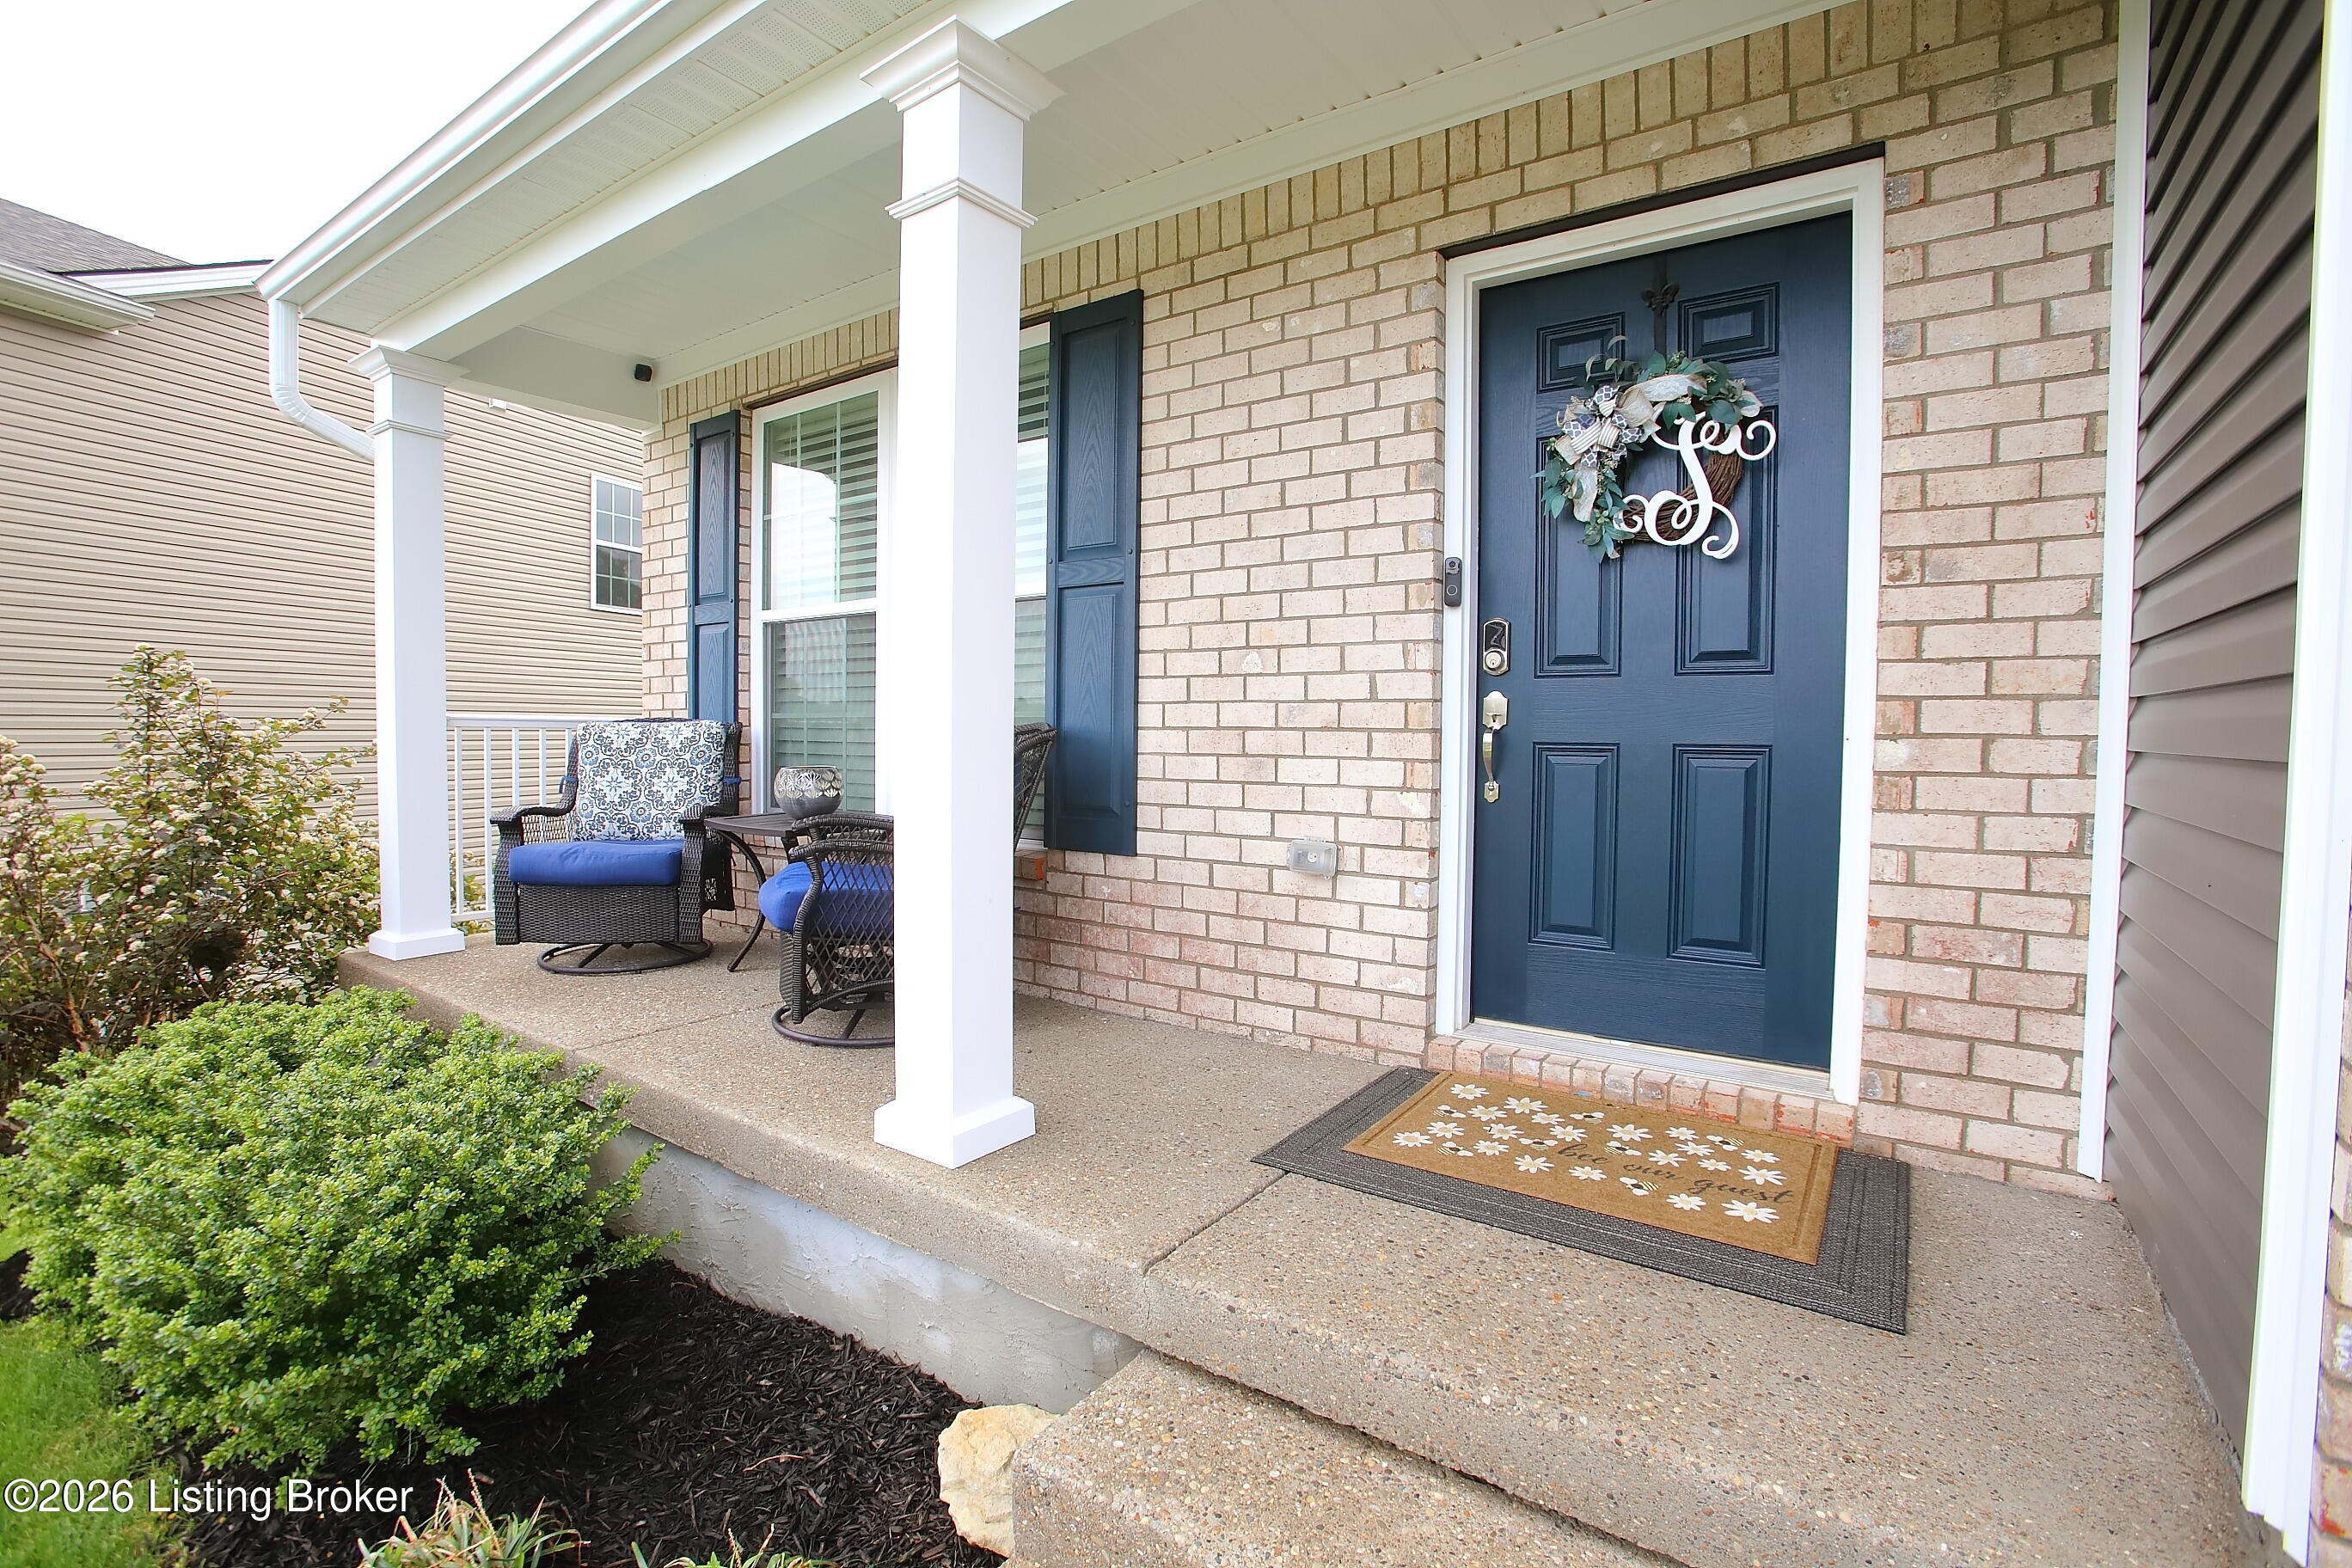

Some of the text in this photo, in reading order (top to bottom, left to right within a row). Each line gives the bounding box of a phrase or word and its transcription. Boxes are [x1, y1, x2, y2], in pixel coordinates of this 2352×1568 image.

[1557, 1143, 1795, 1204] bee our guest
